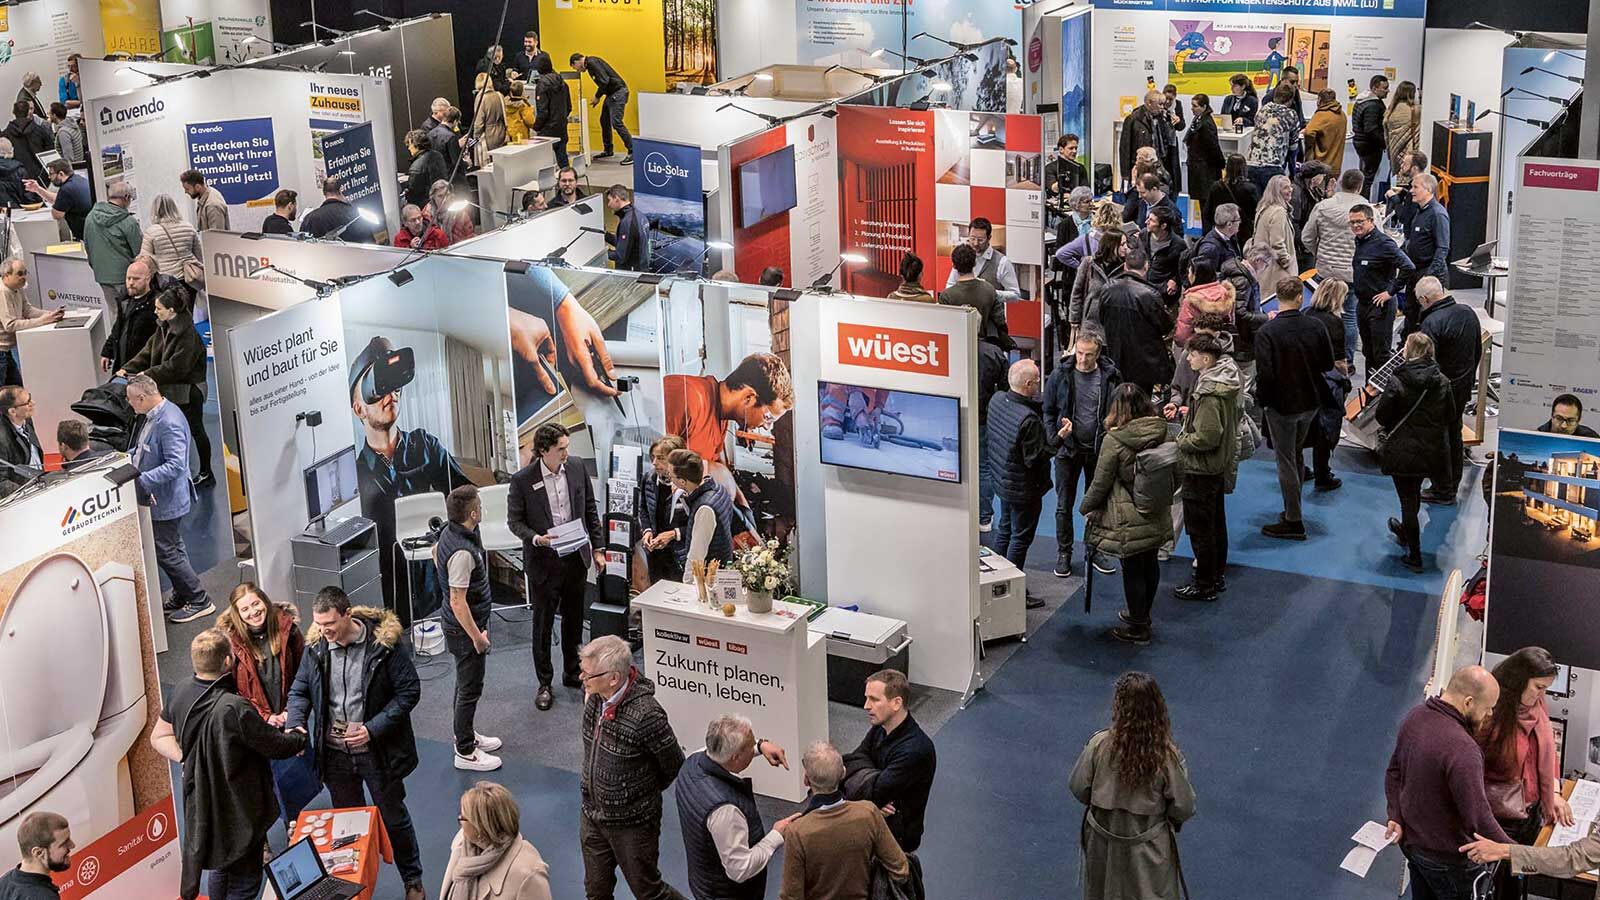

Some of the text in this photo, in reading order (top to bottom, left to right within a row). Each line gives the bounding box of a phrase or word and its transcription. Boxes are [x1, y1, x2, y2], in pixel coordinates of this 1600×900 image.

[111, 36, 157, 51] JAHRE
[310, 82, 359, 97] Ihr neues
[116, 96, 165, 122] avendo
[311, 96, 361, 111] Zuhause!
[197, 126, 223, 134] avendo
[192, 137, 269, 153] Entdecken Sie
[193, 149, 273, 164] den Wert Ihrer
[328, 147, 372, 170] Erfahren Sie
[353, 162, 367, 174] den
[647, 161, 689, 178] Lio-Solar
[1529, 168, 1578, 180] Fachvorträge
[220, 174, 242, 185] und
[244, 171, 273, 185] jetzt!
[339, 174, 369, 192] ert Ihrer
[56, 292, 102, 304] WATERKOTTE
[243, 326, 314, 365] Wüest plant
[847, 333, 940, 367] wüest
[246, 339, 338, 388] und baut für Sie
[289, 377, 304, 389] Hand
[81, 486, 121, 517] GUT
[655, 649, 785, 692] Zukunft planen,
[656, 670, 767, 707] bauen, leben.
[117, 833, 145, 856] Sanitär
